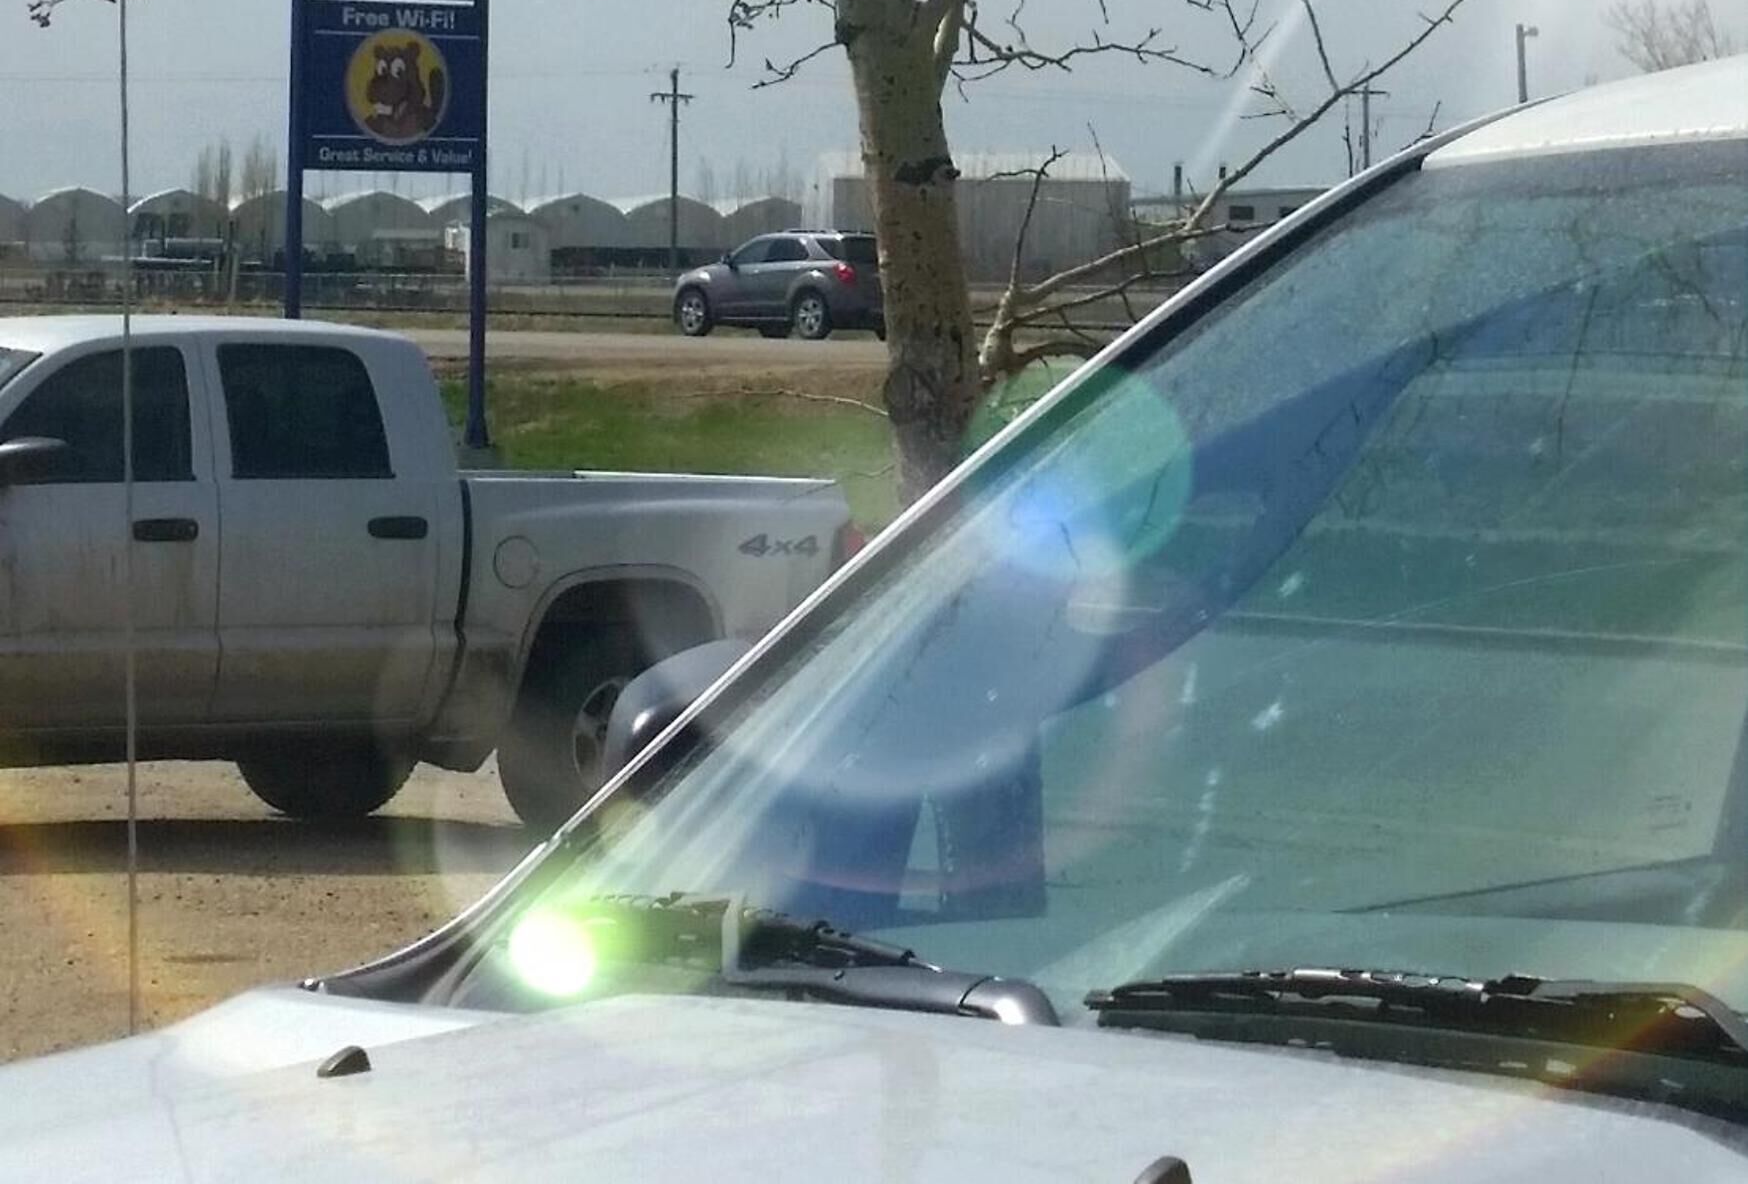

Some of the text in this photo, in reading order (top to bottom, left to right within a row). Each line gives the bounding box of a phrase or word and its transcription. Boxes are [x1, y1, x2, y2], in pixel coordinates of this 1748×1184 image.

[342, 6, 390, 26] Free
[319, 146, 360, 162] Great
[363, 147, 415, 163] Service
[417, 148, 428, 165] &
[738, 533, 820, 558] 4x4
